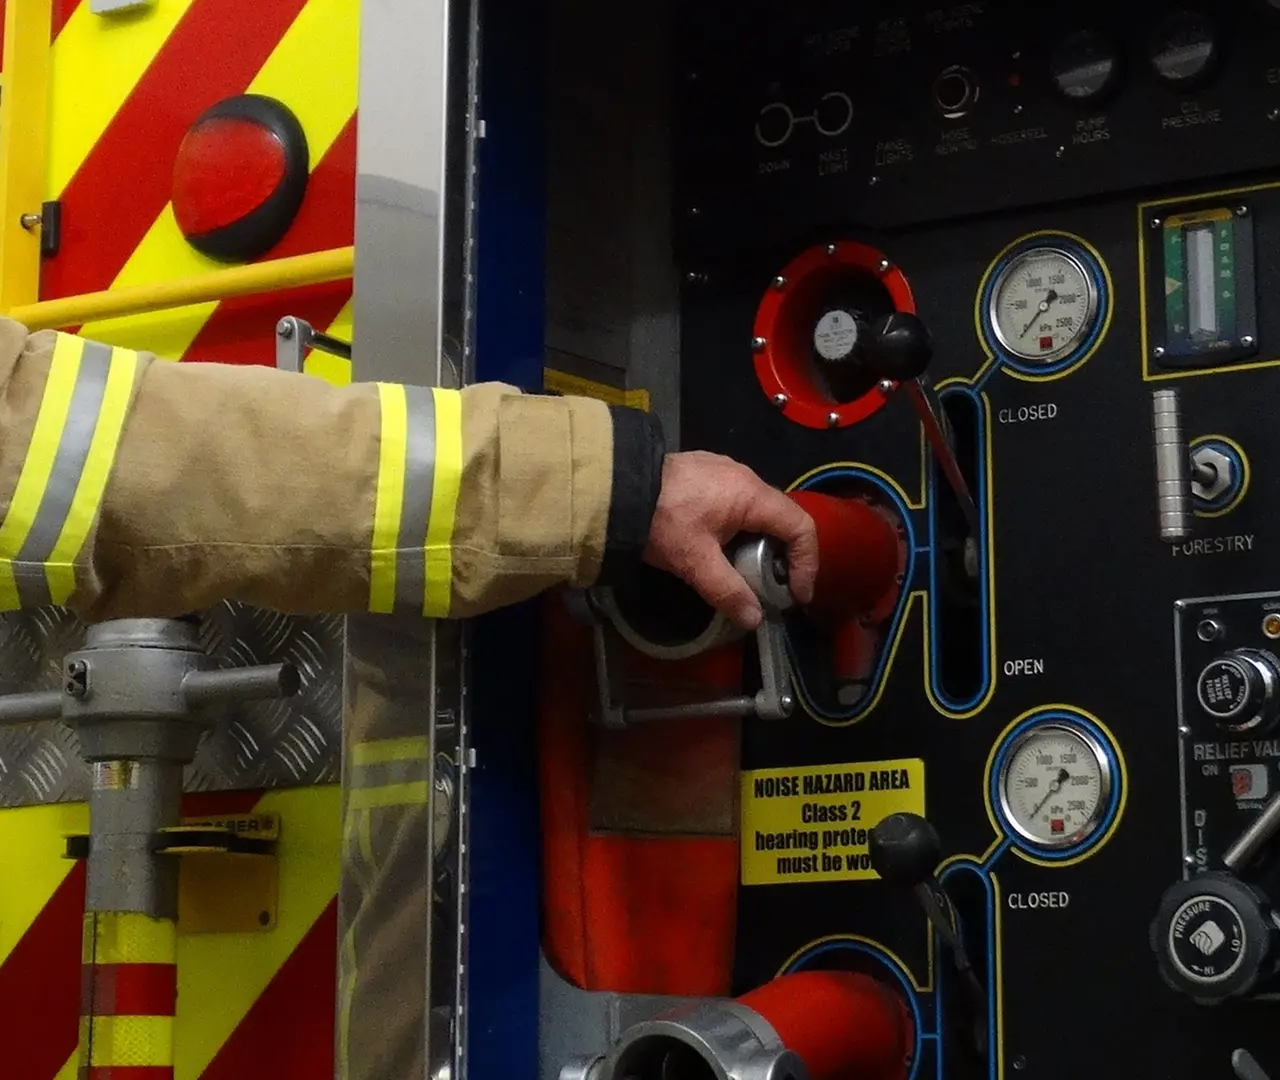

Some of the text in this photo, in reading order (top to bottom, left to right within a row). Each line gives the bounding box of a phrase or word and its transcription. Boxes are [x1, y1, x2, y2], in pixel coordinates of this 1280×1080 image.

[1076, 116, 1107, 131] PUMP
[1161, 109, 1222, 129] PRESSURE
[1072, 129, 1111, 145] HOURS
[759, 159, 791, 174] DOWN
[999, 403, 1057, 424] CLOSED
[1171, 534, 1255, 556] FORESTRY
[1004, 658, 1044, 676] OPEN
[1193, 741, 1249, 761] RELIEF
[1201, 764, 1219, 776] ON
[754, 769, 910, 798] NOISE HAZARD AREA
[802, 801, 861, 824] Class 2
[755, 827, 870, 853] hearing prote
[777, 852, 871, 875] must be wo
[1008, 893, 1070, 909] CLOSED
[1174, 901, 1211, 939] PRESSURE
